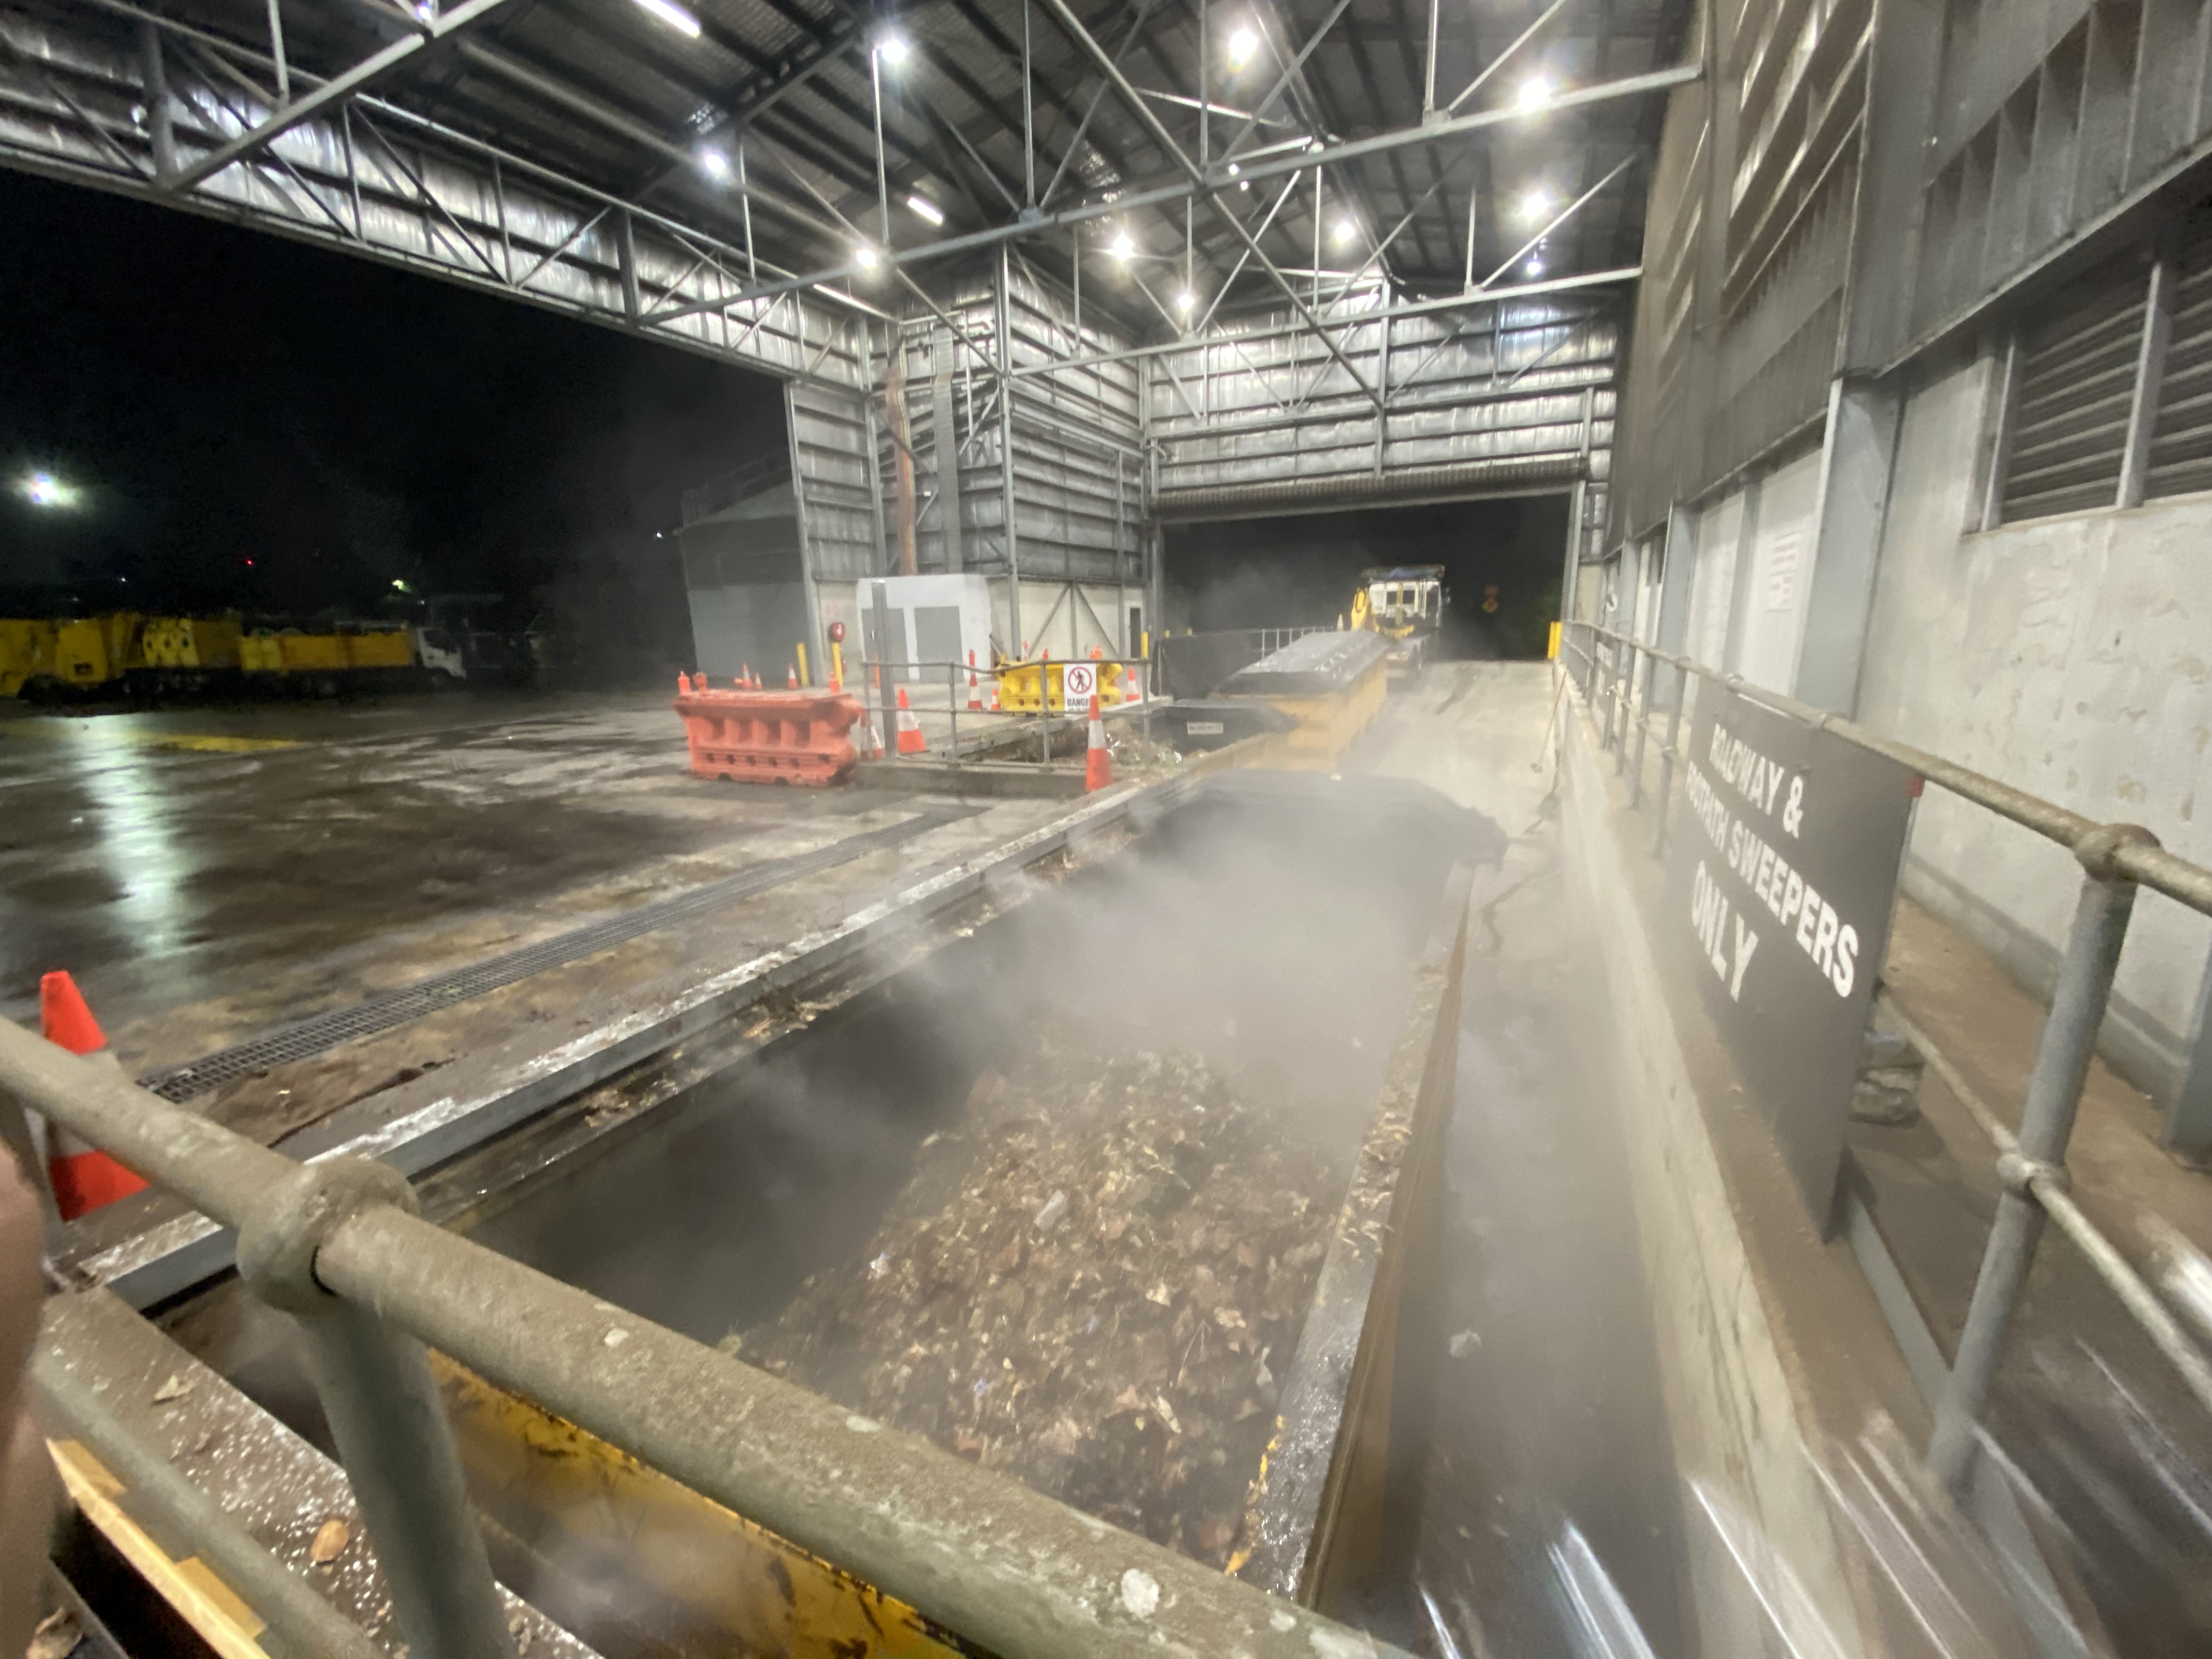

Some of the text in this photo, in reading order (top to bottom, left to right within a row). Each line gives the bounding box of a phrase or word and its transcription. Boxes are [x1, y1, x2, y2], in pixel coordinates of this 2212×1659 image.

[1067, 698, 1089, 707] DANGE
[1783, 775, 1803, 839] &
[1691, 860, 1759, 1003] ONLY
[1729, 820, 1858, 998] SWEEPERS
